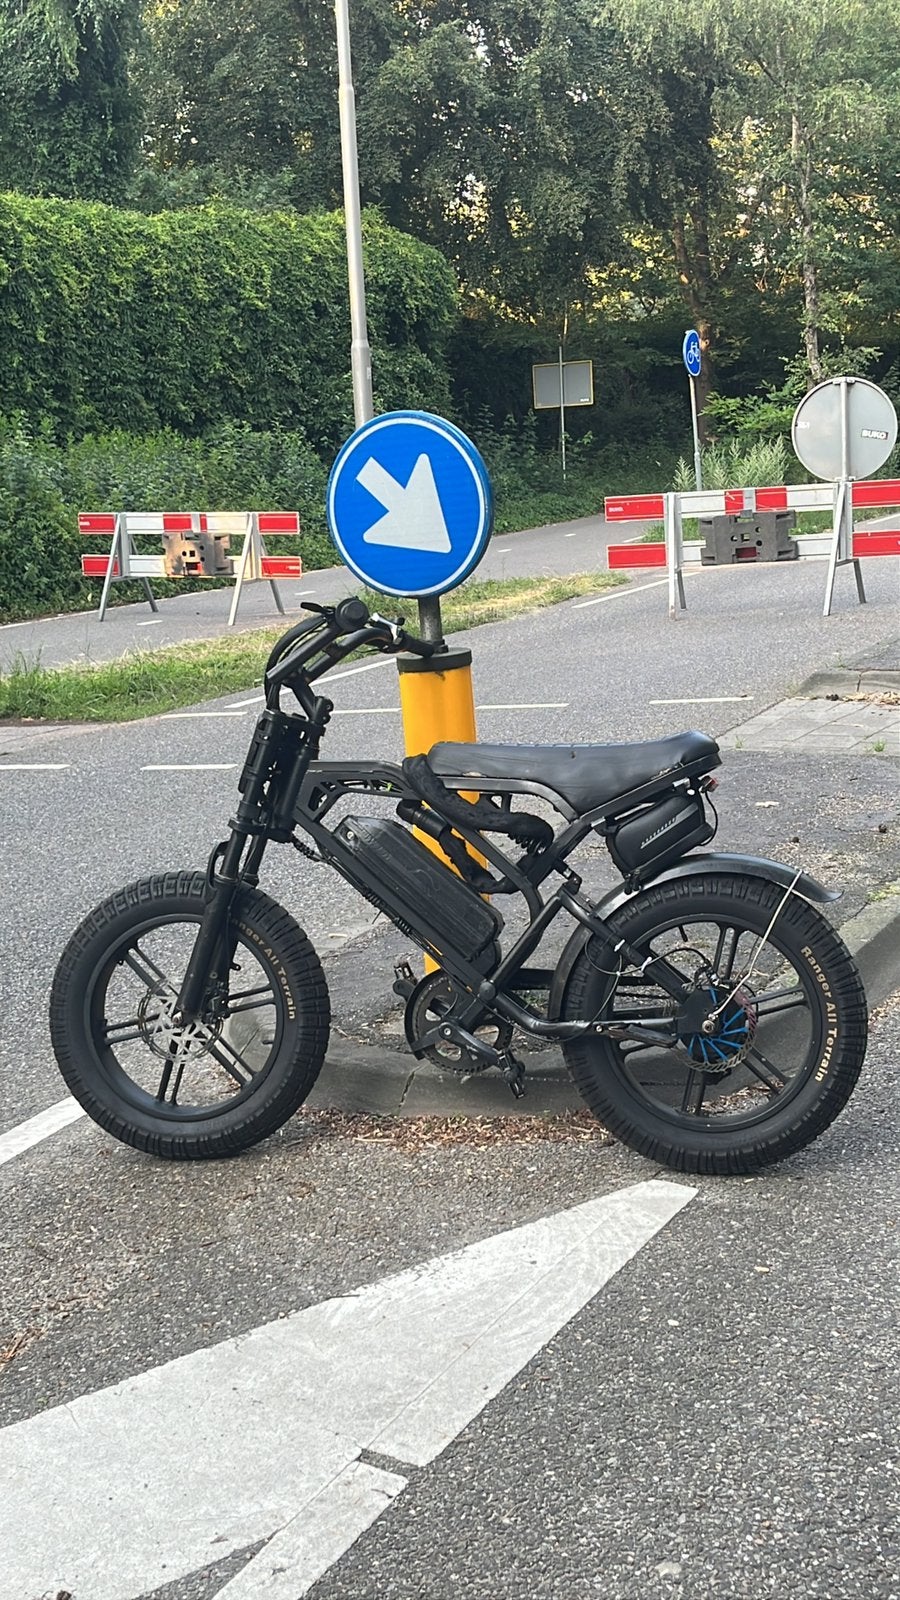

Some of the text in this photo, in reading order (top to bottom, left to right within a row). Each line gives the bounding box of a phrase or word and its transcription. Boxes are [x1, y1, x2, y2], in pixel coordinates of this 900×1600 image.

[862, 429, 887, 440] BUKO
[264, 948, 280, 965] All
[278, 967, 296, 1020] Terrain
[801, 946, 838, 1082] Ranger All Terrain
